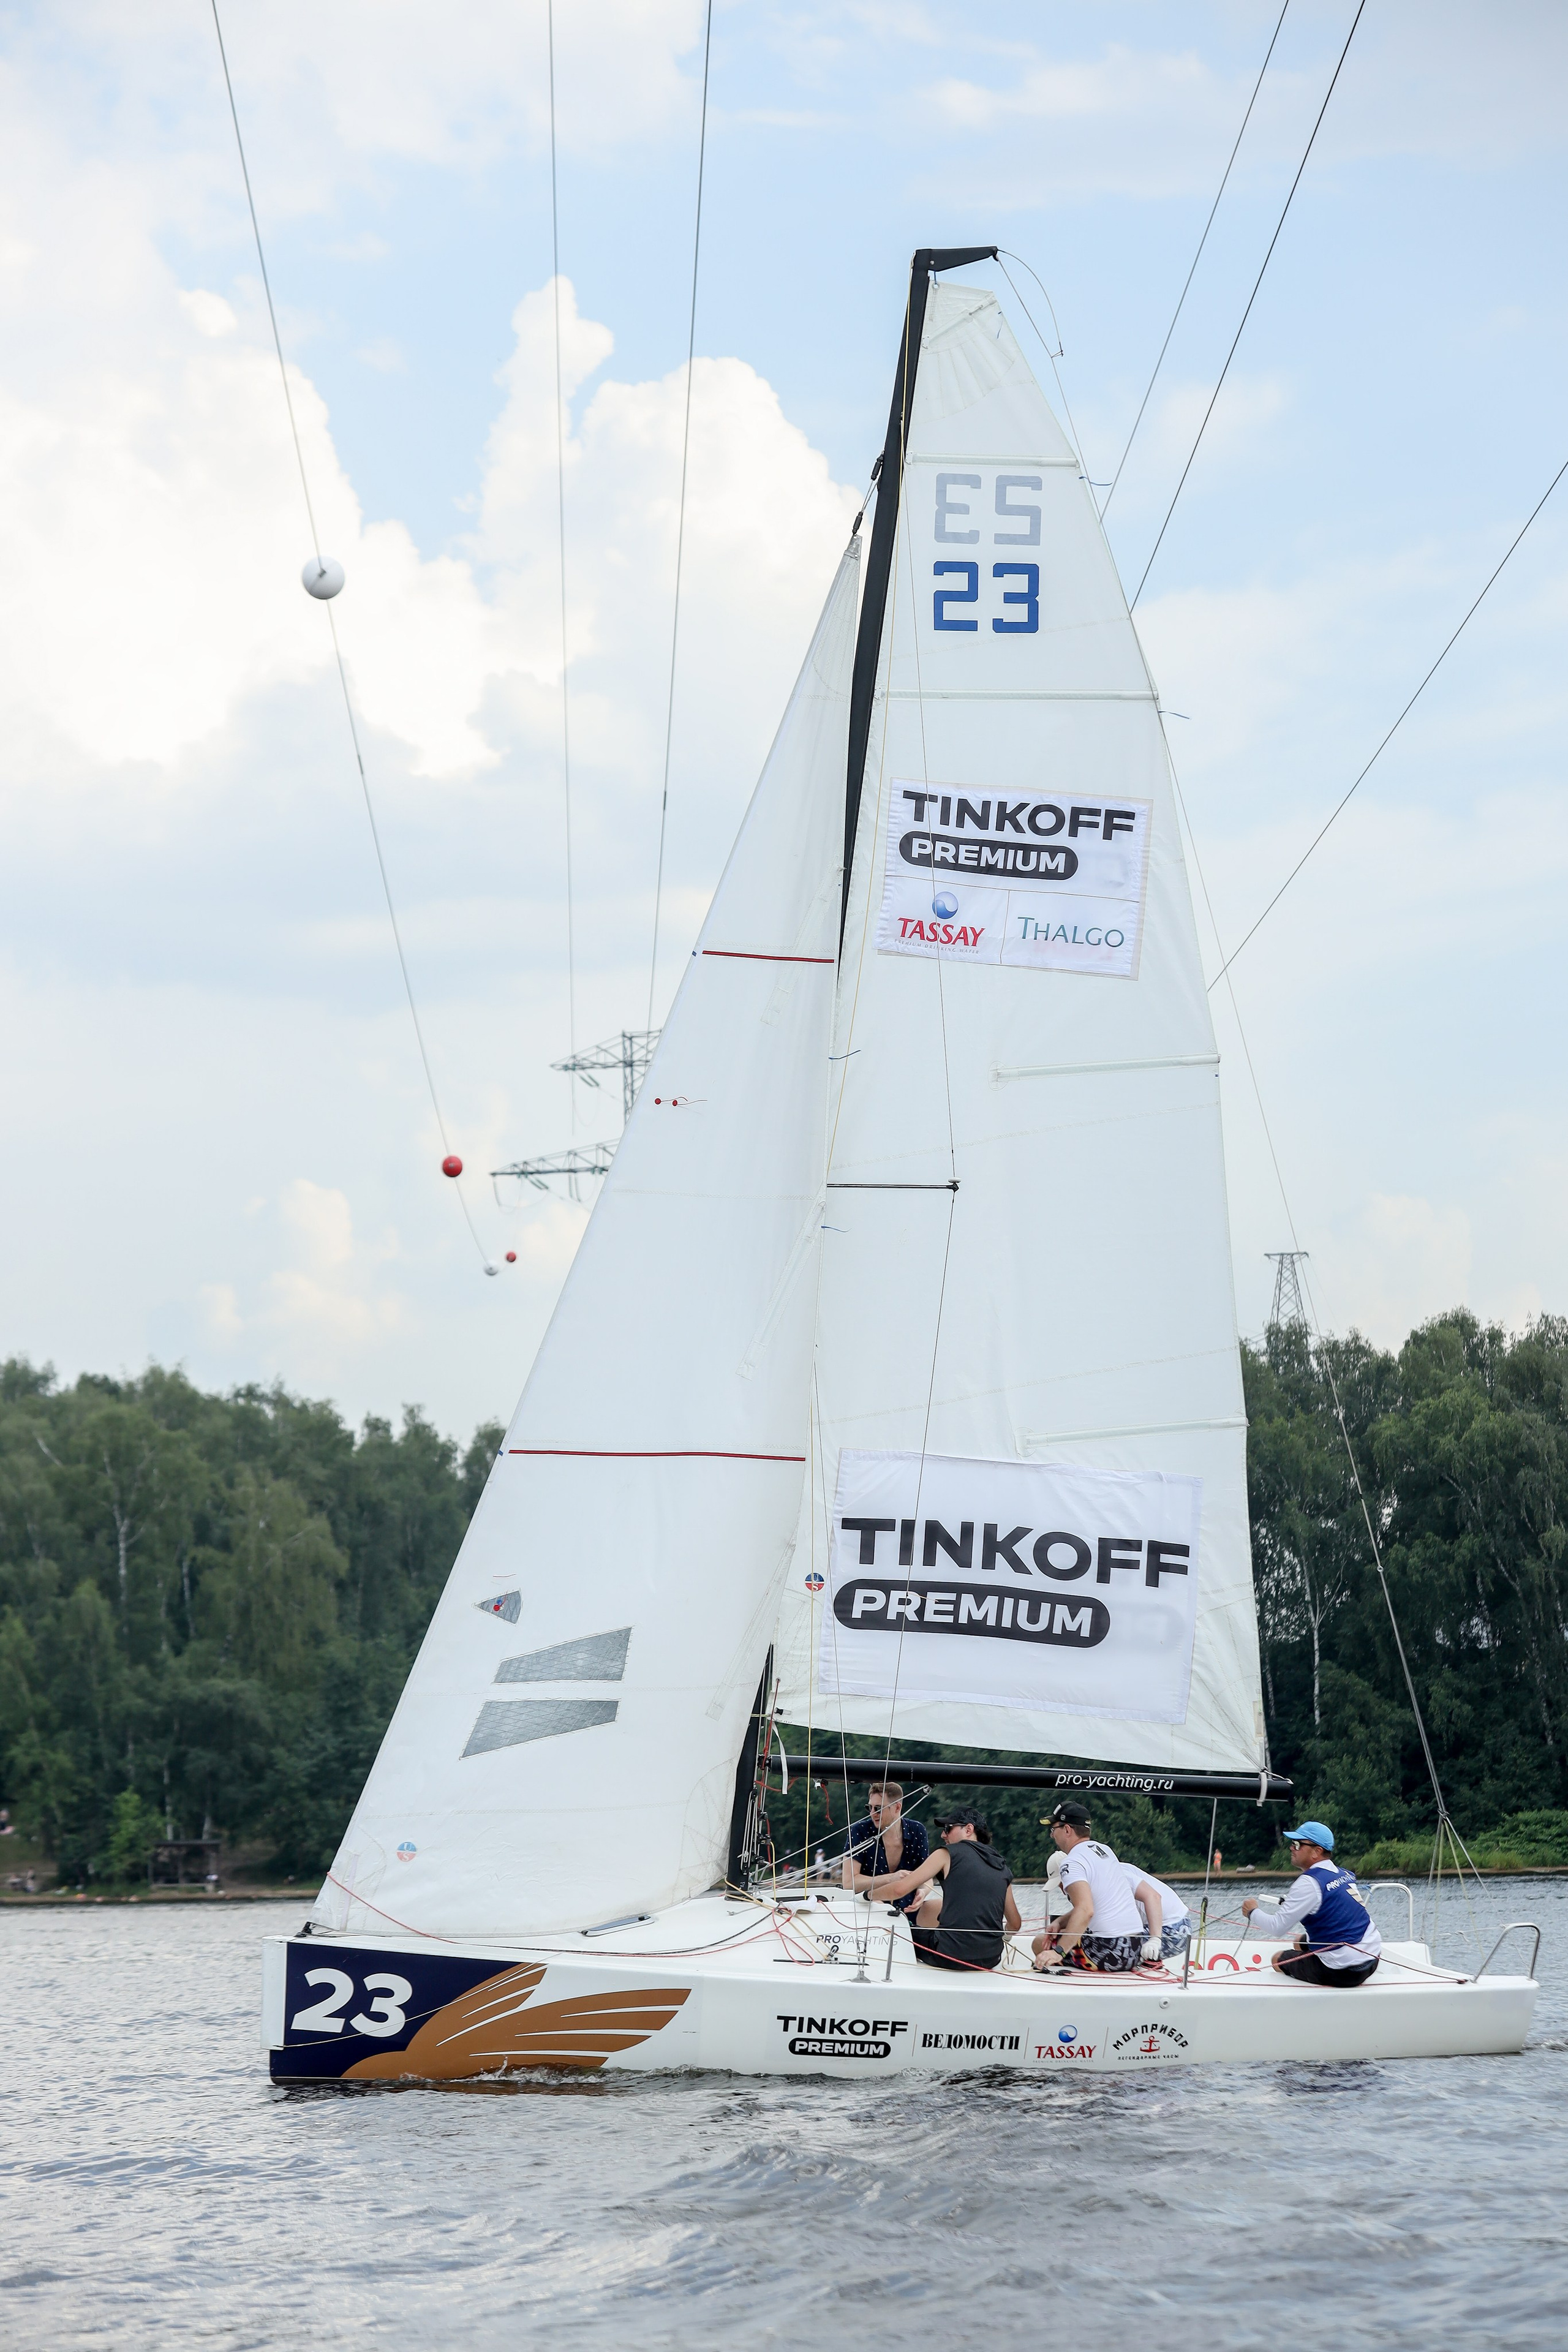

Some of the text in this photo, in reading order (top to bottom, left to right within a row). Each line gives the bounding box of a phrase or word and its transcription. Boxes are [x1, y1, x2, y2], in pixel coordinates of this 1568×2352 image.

[933, 560, 1040, 634] 23
[902, 790, 1136, 841] TINKOFF
[910, 837, 1067, 874] PREMIUM
[894, 938, 922, 948] PREMIUM
[897, 917, 986, 947] TASSAY
[1017, 916, 1125, 948] THALGO
[841, 1517, 1190, 1588] TINKOFF
[851, 1588, 1093, 1638] PREMIUM
[1055, 1774, 1174, 1792] pro-yachting.ru
[290, 1967, 413, 2038] 23
[777, 2015, 908, 2037] TINKOFF
[1112, 2023, 1189, 2051] МОРПРИБОР
[794, 2040, 886, 2056] PREMIUM
[921, 2033, 1021, 2051] ВЕДОМОСТИ
[1034, 2045, 1097, 2059] TASSAY
